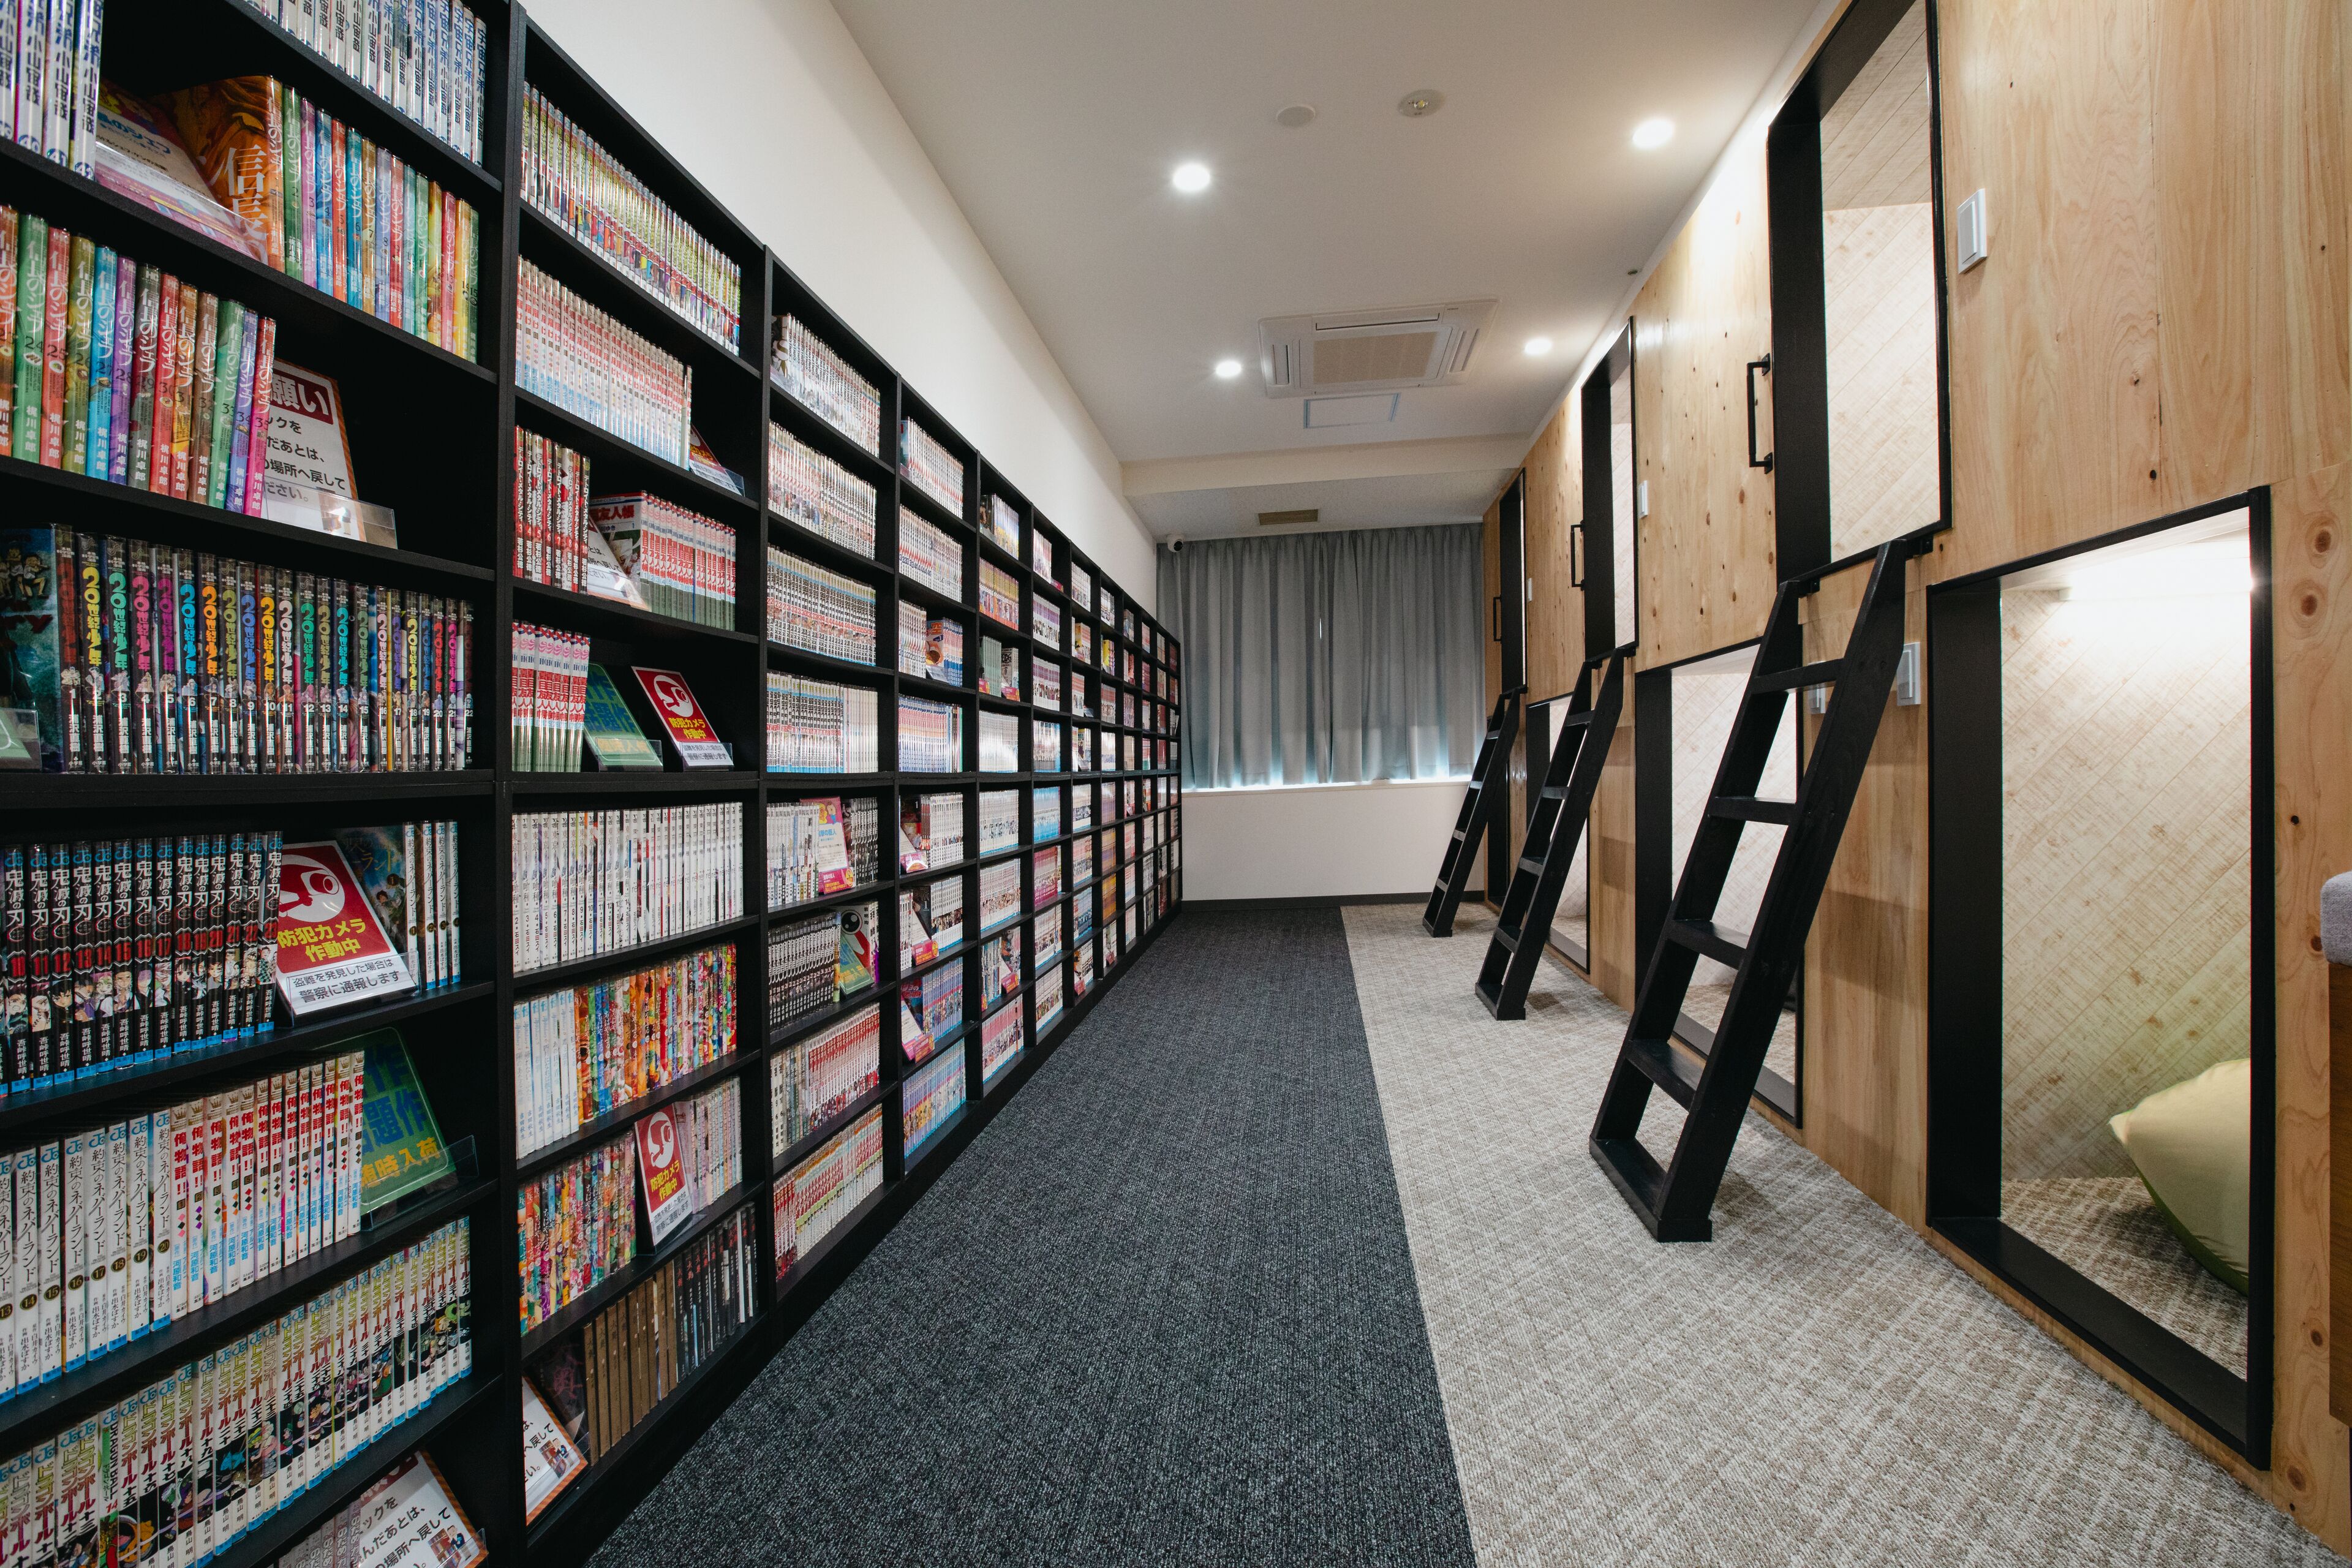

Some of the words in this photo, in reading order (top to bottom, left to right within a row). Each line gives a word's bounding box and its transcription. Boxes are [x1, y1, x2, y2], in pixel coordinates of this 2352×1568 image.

[25, 336, 43, 353] 24
[47, 344, 67, 360] 25
[236, 412, 251, 422] 34
[519, 524, 523, 533] 3
[537, 529, 542, 538] 5
[108, 571, 127, 670] 20世紀少年
[120, 692, 127, 703] 3
[132, 575, 151, 671] 20世紀少年
[180, 583, 197, 676] 20世紀少年
[189, 698, 196, 707] 6
[241, 594, 256, 681] 20世紀少年
[260, 597, 275, 682] 20世紀少年
[279, 600, 293, 684] 20世紀少年
[301, 603, 314, 685] 20世紀少年
[336, 607, 349, 687] 20世紀少年
[222, 590, 237, 677] 20世紀少年
[230, 699, 238, 708] 8
[407, 617, 418, 692] 20世紀少年
[69, 688, 77, 699] 1
[141, 694, 150, 703] 4
[167, 694, 175, 704] 5
[210, 697, 217, 706] 7
[247, 702, 255, 710] 9
[266, 702, 276, 710] 10
[304, 704, 314, 712] 12
[337, 705, 348, 714] 14
[359, 706, 369, 715] 15
[409, 709, 418, 717] 18
[668, 717, 706, 728] 防犯カメラ
[683, 728, 706, 739] 作動中
[5, 869, 24, 927] 鬼滅の刃
[30, 870, 49, 927] 鬼滅の刃
[51, 869, 70, 924] 鬼滅の刃
[73, 866, 92, 921] 鬼滅の刃
[94, 865, 111, 919] 鬼滅の刃
[113, 862, 132, 916] 鬼滅の刃
[156, 861, 172, 911] 鬼滅の刃
[176, 856, 193, 907] 鬼滅の刃
[209, 856, 226, 905] 鬼滅の刃
[228, 852, 244, 900] 鬼滅の刃
[247, 852, 262, 900] 鬼滅の刃
[265, 851, 282, 898] 鬼滅の刃
[277, 918, 366, 949] 防犯カメラ
[305, 937, 361, 962] 作動中
[293, 959, 394, 989] 盗難を発見した場合は
[299, 970, 400, 1003] 警察に通報します
[109, 1142, 127, 1246] 約束のネバーランド
[130, 1136, 148, 1237] 約束のネバーランド
[154, 1128, 170, 1228] 約束のネバーランド
[650, 1159, 680, 1193] 防犯カメラ
[659, 1177, 677, 1201] 作動中
[40, 1163, 60, 1273] 約束のネバーランド
[66, 1156, 83, 1264] 約束のネバーランド
[88, 1148, 105, 1254] 約束のネバーランド
[17, 1170, 37, 1283] 約束のネバーランド
